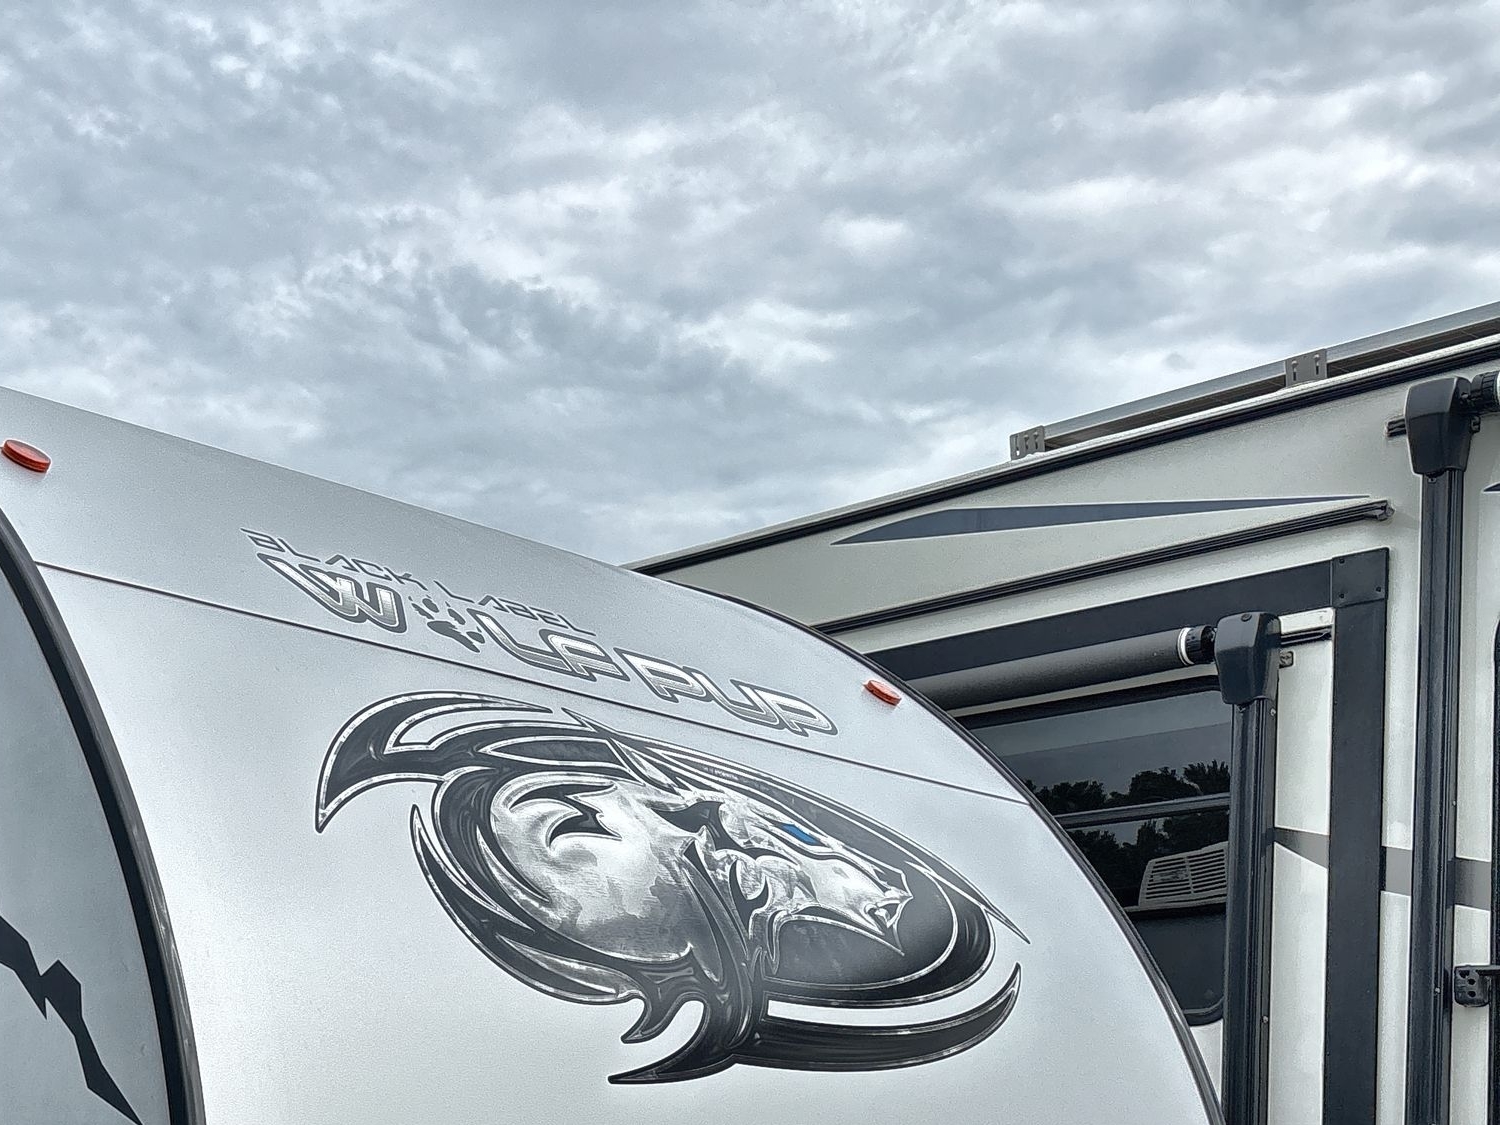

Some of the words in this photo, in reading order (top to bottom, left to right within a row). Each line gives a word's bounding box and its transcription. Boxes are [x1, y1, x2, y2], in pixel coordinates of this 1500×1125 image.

[240, 528, 428, 591] BLACK
[433, 579, 596, 636] LABEL
[613, 647, 839, 737] PUP
